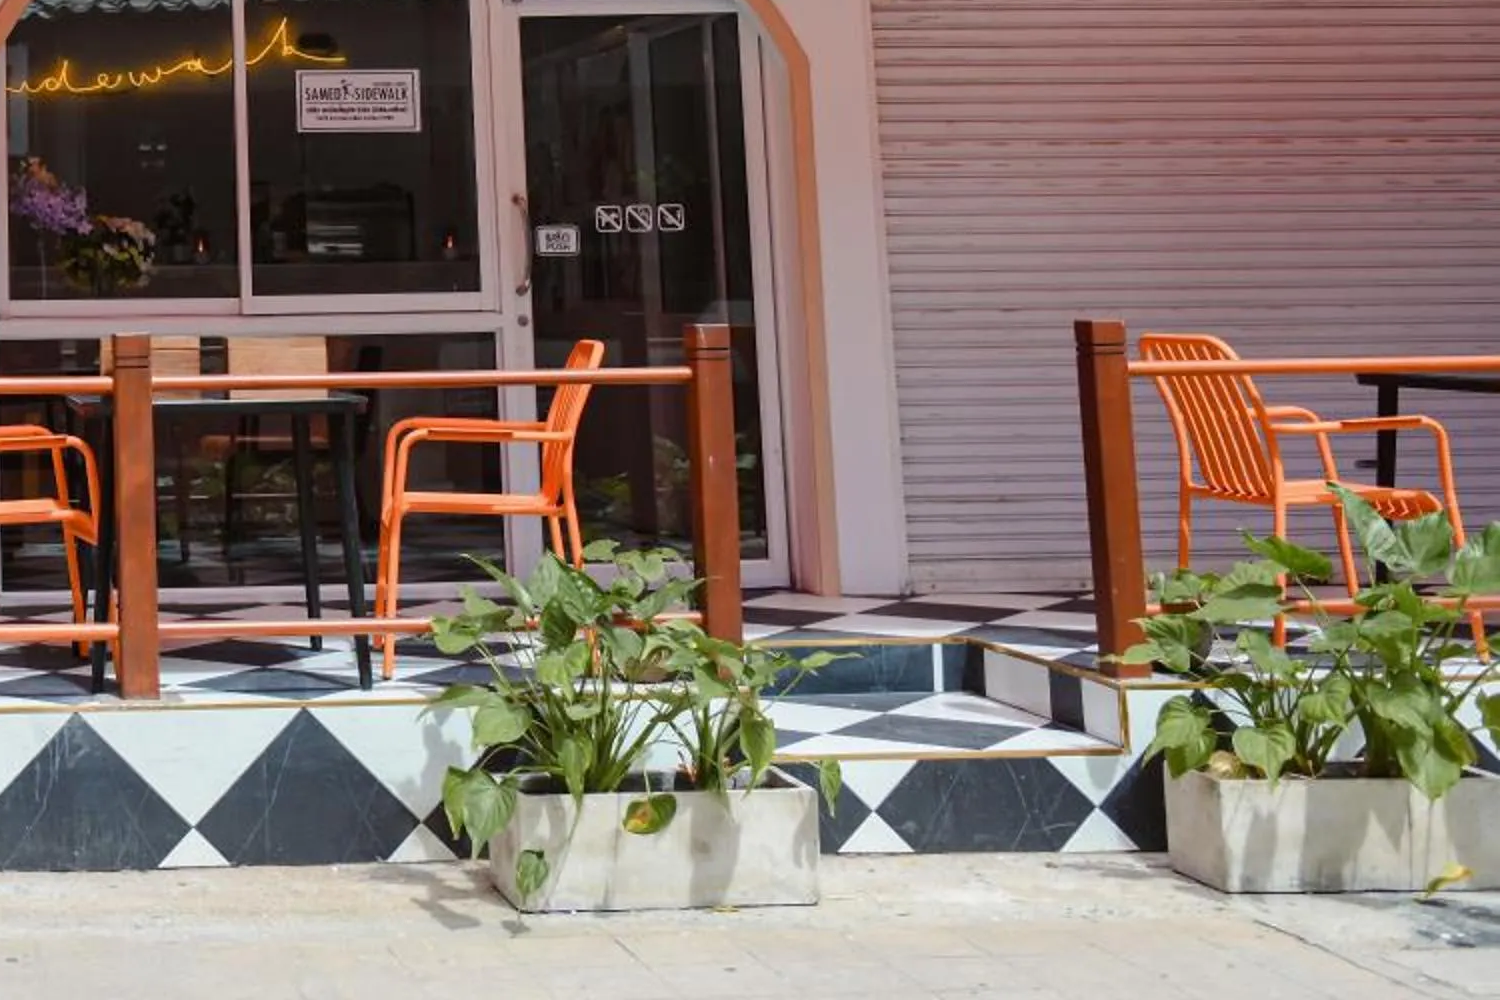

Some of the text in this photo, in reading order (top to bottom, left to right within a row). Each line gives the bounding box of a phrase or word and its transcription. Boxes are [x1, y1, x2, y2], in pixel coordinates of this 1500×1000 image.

[5, 17, 347, 93] idewak
[305, 87, 408, 101] SAMED SIDEWALK
